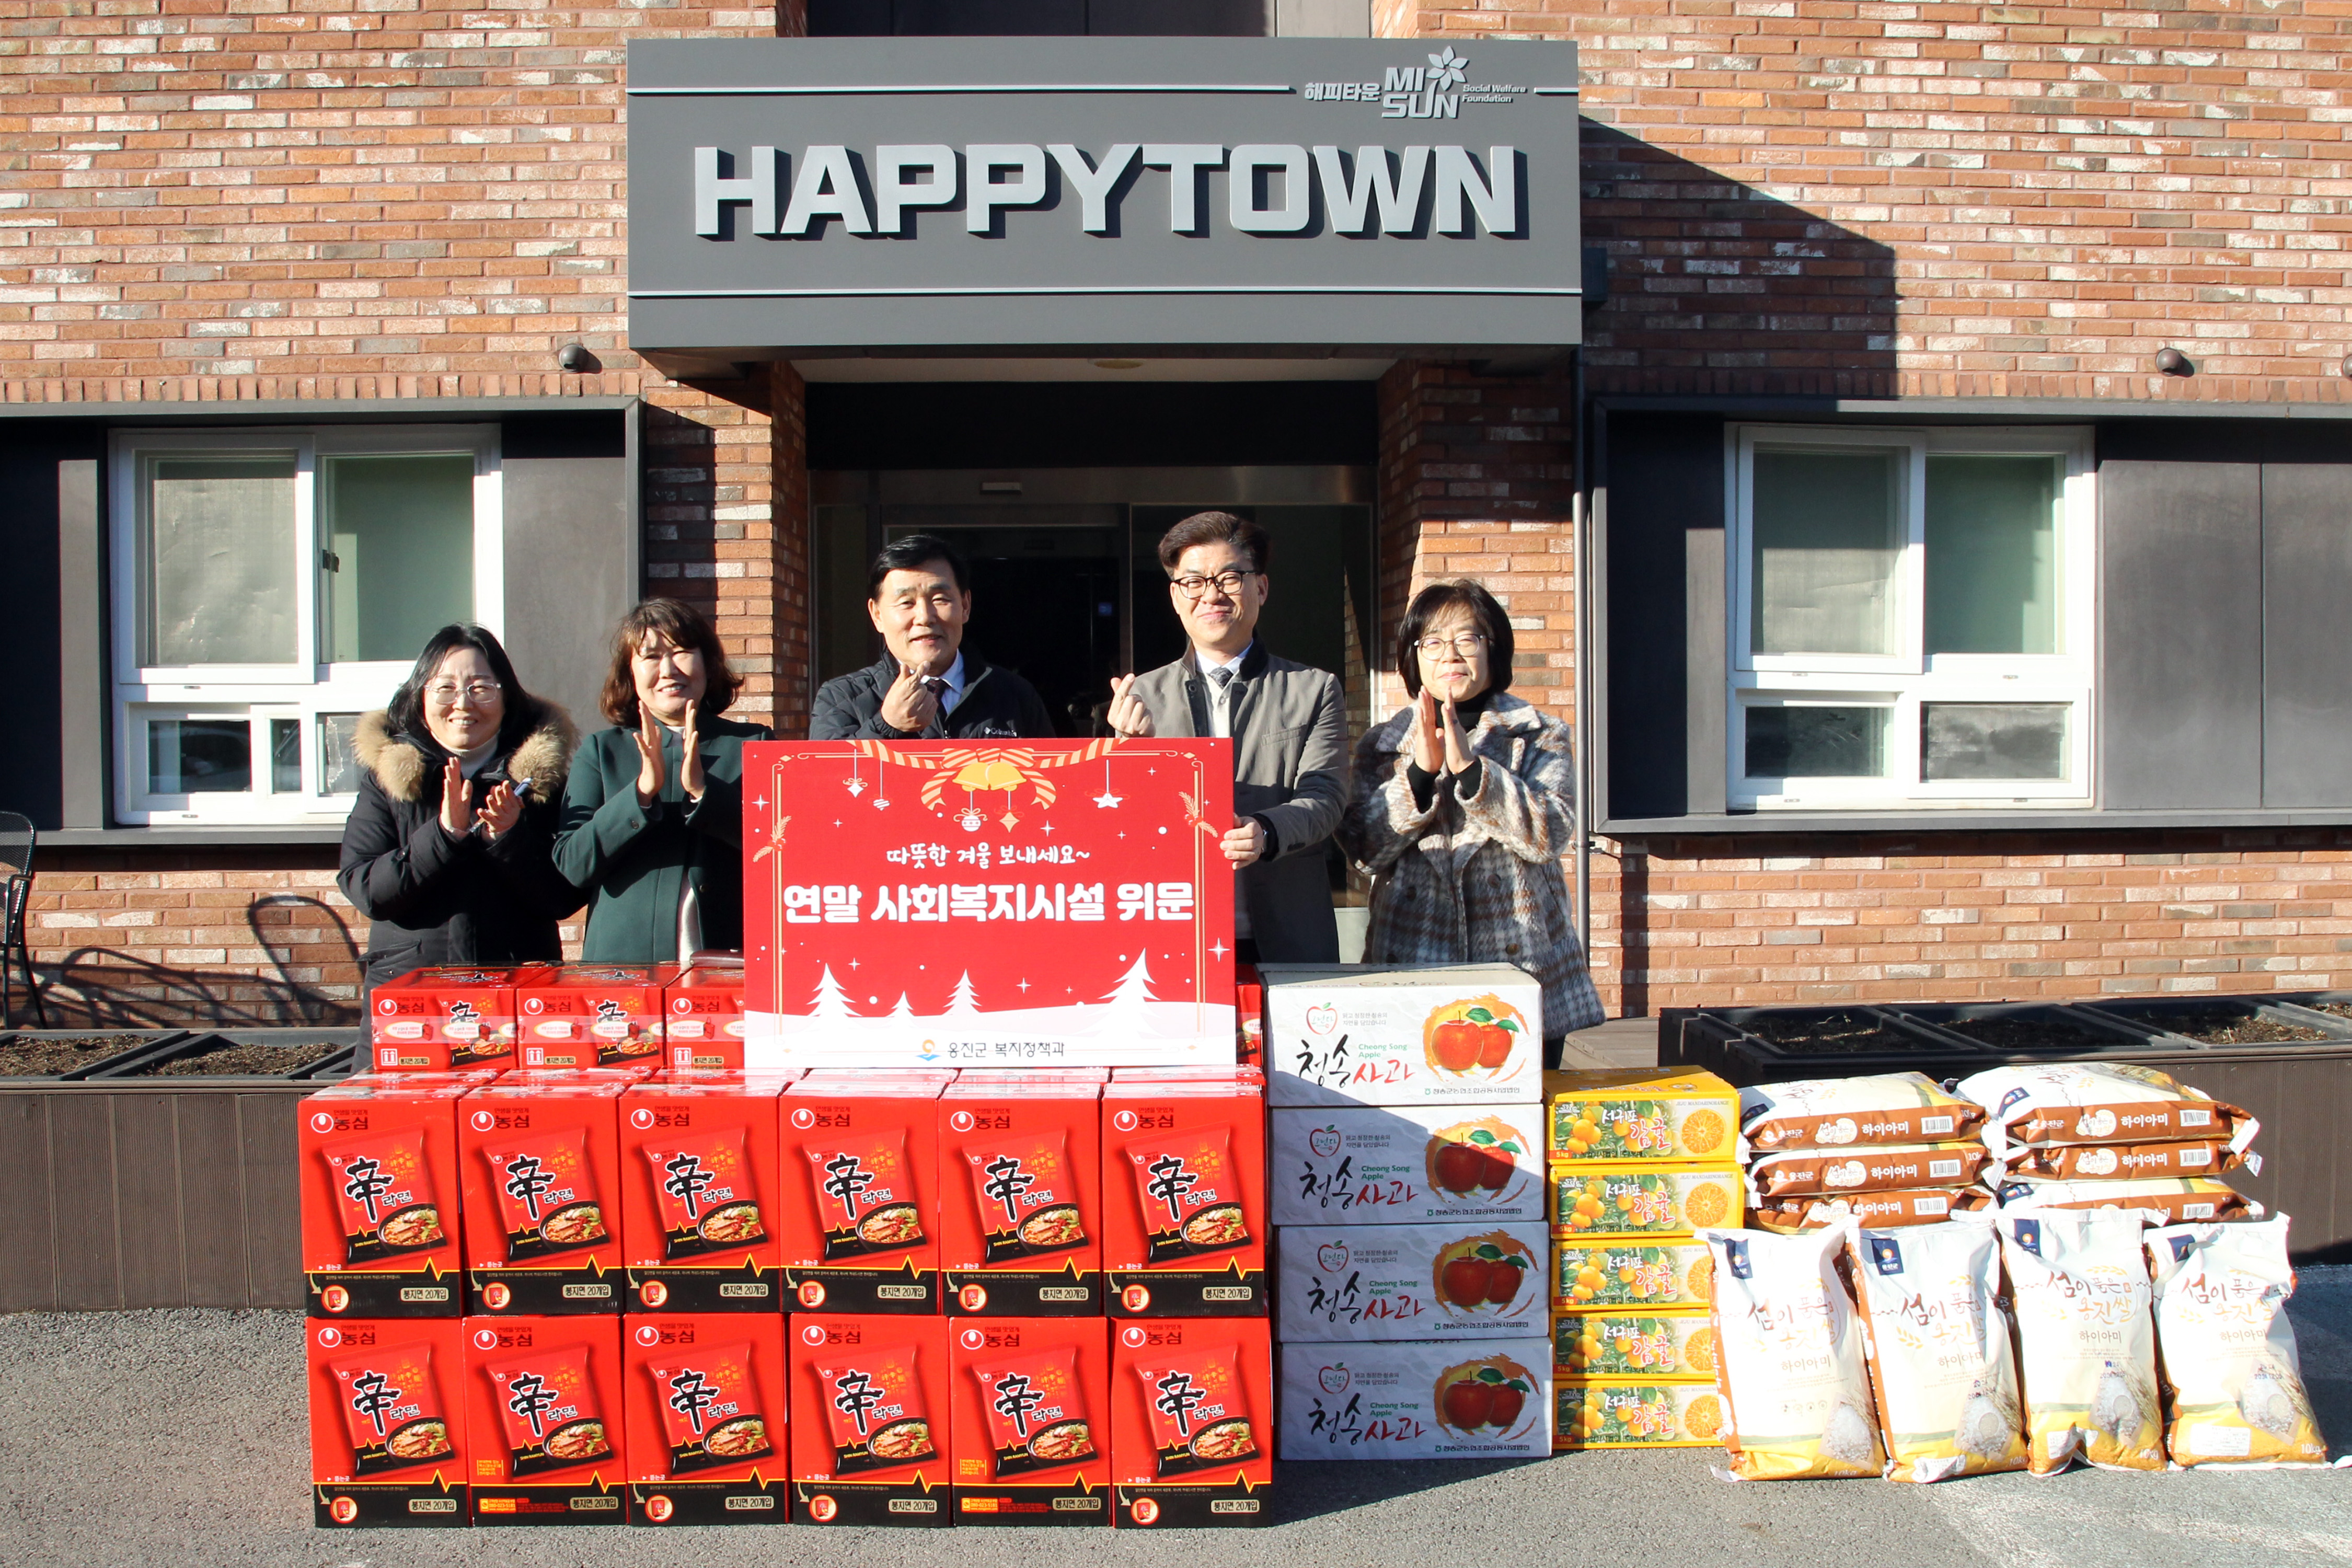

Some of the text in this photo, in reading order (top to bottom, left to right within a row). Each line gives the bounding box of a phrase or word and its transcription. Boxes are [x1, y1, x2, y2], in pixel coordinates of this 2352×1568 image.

[1385, 67, 1426, 91] MI
[1305, 83, 1380, 101] 해피타운
[1462, 95, 1513, 103] Foundation
[1381, 93, 1460, 119] SUN
[695, 145, 1517, 235] HAPPYTOWN
[886, 842, 1090, 870] 따뜻한 겨울 보내세요~
[783, 881, 1194, 924] 연말 사회복지시설 위문
[397, 1003, 424, 1013] 농심
[543, 1002, 571, 1012] 농심
[691, 1001, 720, 1012] 농심
[947, 1041, 1065, 1059] 옹진군 복지정책과
[334, 1117, 368, 1131] 농심
[494, 1115, 529, 1129] 농심
[654, 1113, 689, 1127] 농심
[815, 1113, 851, 1127] 농심
[974, 1115, 1010, 1129] 농심
[1138, 1114, 1174, 1128] 농심
[1602, 1109, 1639, 1123] 서귀포
[2120, 1113, 2168, 1129] 하이아미
[1630, 1119, 1671, 1150] 감귤
[1861, 1121, 1909, 1140] 하이아미
[2121, 1152, 2167, 1168] 하이아미
[1870, 1164, 1918, 1179] 하이아미
[345, 1156, 395, 1223] 辛
[506, 1154, 556, 1221] 辛
[665, 1152, 714, 1219] 辛
[825, 1153, 874, 1220] 辛
[985, 1154, 1035, 1223] 辛
[1148, 1154, 1198, 1223] 辛
[1606, 1183, 1642, 1197] 서귀포
[382, 1190, 413, 1207] 라면
[543, 1187, 575, 1205] 라면
[701, 1186, 733, 1204] 라면
[861, 1187, 893, 1205] 라면
[1021, 1189, 1054, 1207] 라면
[1185, 1189, 1217, 1206] 라면
[1634, 1192, 1675, 1224] 감귤
[1852, 1201, 1903, 1216] 하이아미
[1607, 1255, 1644, 1270] 서귀포
[1636, 1265, 1677, 1297] 감귤
[2046, 1270, 2092, 1298] 섬이
[2181, 1273, 2228, 1304] 섬이
[403, 1289, 446, 1300] 봉지면 20개입
[565, 1285, 609, 1297] 봉지면 20개입
[722, 1285, 766, 1296] 봉지면 20개입
[880, 1287, 924, 1298] 봉지면 20개입
[1042, 1288, 1086, 1299] 봉지면 20개입
[1205, 1288, 1249, 1299] 봉지면 20개입
[341, 1332, 376, 1345] 농심
[498, 1334, 532, 1347] 농심
[659, 1330, 694, 1344] 농심
[825, 1330, 861, 1344] 농심
[984, 1333, 1020, 1347] 농심
[1146, 1331, 1182, 1345] 농심
[1604, 1325, 1641, 1340] 서귀포
[2079, 1330, 2122, 1344] 하이아미
[2219, 1329, 2267, 1343] 하이아미
[1633, 1335, 1674, 1367] 감귤
[1781, 1354, 1831, 1373] 하이아미
[354, 1370, 402, 1436] 辛
[511, 1371, 559, 1437] 辛
[671, 1368, 719, 1434] 辛
[836, 1369, 885, 1436] 辛
[996, 1372, 1044, 1438] 辛
[1157, 1369, 1206, 1437] 辛
[1605, 1395, 1642, 1409] 서귀포
[389, 1404, 420, 1421] 라면
[547, 1405, 578, 1422] 라면
[707, 1401, 739, 1419] 라면
[872, 1403, 903, 1421] 라면
[1032, 1405, 1063, 1423] 라면
[1193, 1404, 1225, 1421] 라면
[1633, 1404, 1675, 1436] 감귤
[2300, 1444, 2321, 1455] 10kg
[411, 1500, 454, 1511] 봉지면 20개입
[573, 1498, 592, 1509] 봉지면
[595, 1498, 616, 1508] 20개입
[728, 1497, 771, 1508] 봉지면 20개입
[891, 1501, 935, 1512] 봉지면 20개입
[1055, 1499, 1075, 1509] 봉지면
[1077, 1498, 1099, 1509] 20개입
[1214, 1501, 1258, 1512] 봉지면 20개입
